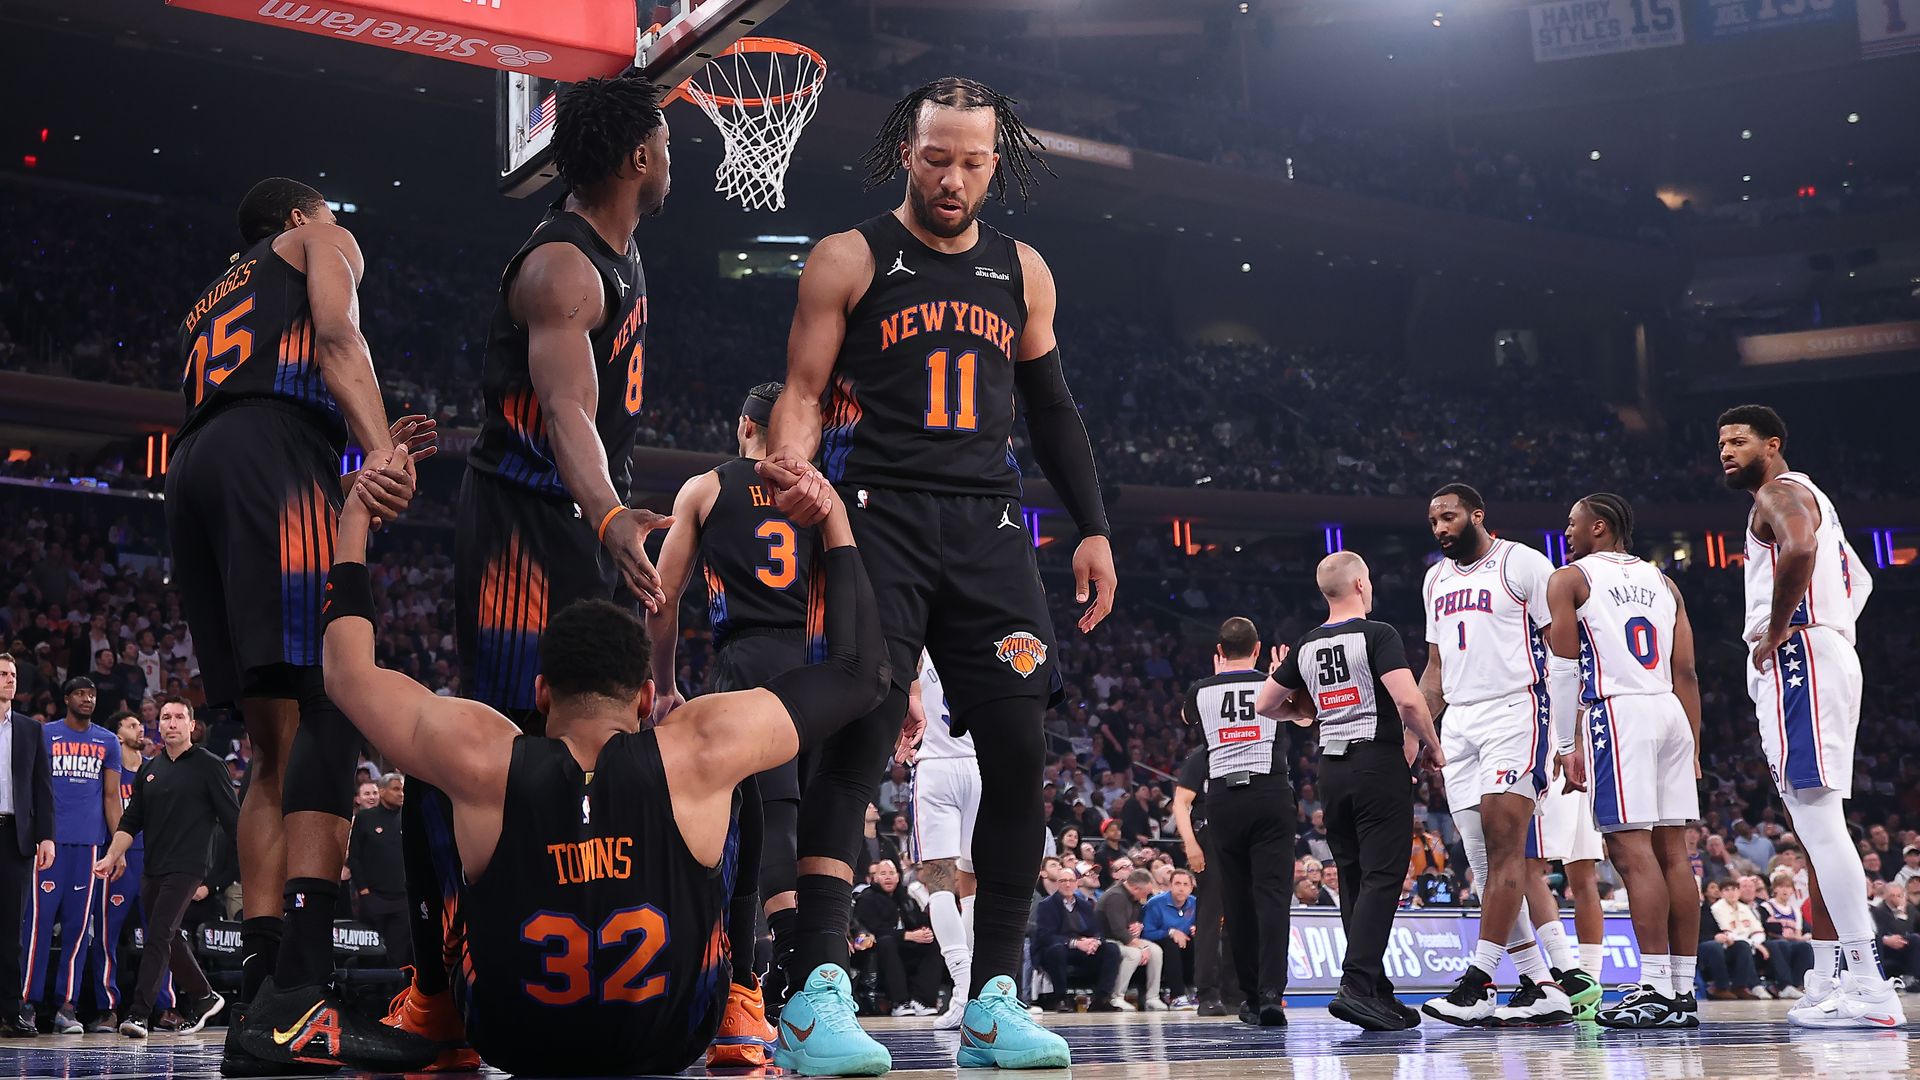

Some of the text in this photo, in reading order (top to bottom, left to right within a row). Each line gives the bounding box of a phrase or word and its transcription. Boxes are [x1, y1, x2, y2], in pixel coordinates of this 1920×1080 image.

[1542, 0, 1610, 25] HARRY
[1631, 0, 1676, 34] 15
[1538, 18, 1621, 47] STYLES
[975, 270, 990, 278] abu
[185, 259, 257, 334] BRIDGES
[881, 301, 1015, 361] NEW YORK
[624, 339, 644, 416] 8
[924, 348, 979, 432] 11
[754, 518, 798, 590] 3
[1434, 588, 1494, 622] PHILA
[1608, 584, 1657, 608] MAXEY
[999, 637, 1044, 658] KNICKS
[1457, 620, 1467, 650] 1
[1624, 616, 1660, 670] 0
[1316, 644, 1351, 686] 39
[1220, 689, 1255, 723] 45
[1322, 691, 1356, 707] Emirates
[1222, 728, 1258, 741] Emirates
[52, 742, 106, 760] ALWAYS
[52, 755, 103, 774] KNICKS
[1495, 769, 1518, 786] 76
[547, 836, 633, 885] TOWNS
[213, 929, 244, 947] PLAYO
[339, 927, 380, 947] PLAYOFFS
[1304, 926, 1422, 977] PLAFFS
[519, 903, 671, 1006] 32
